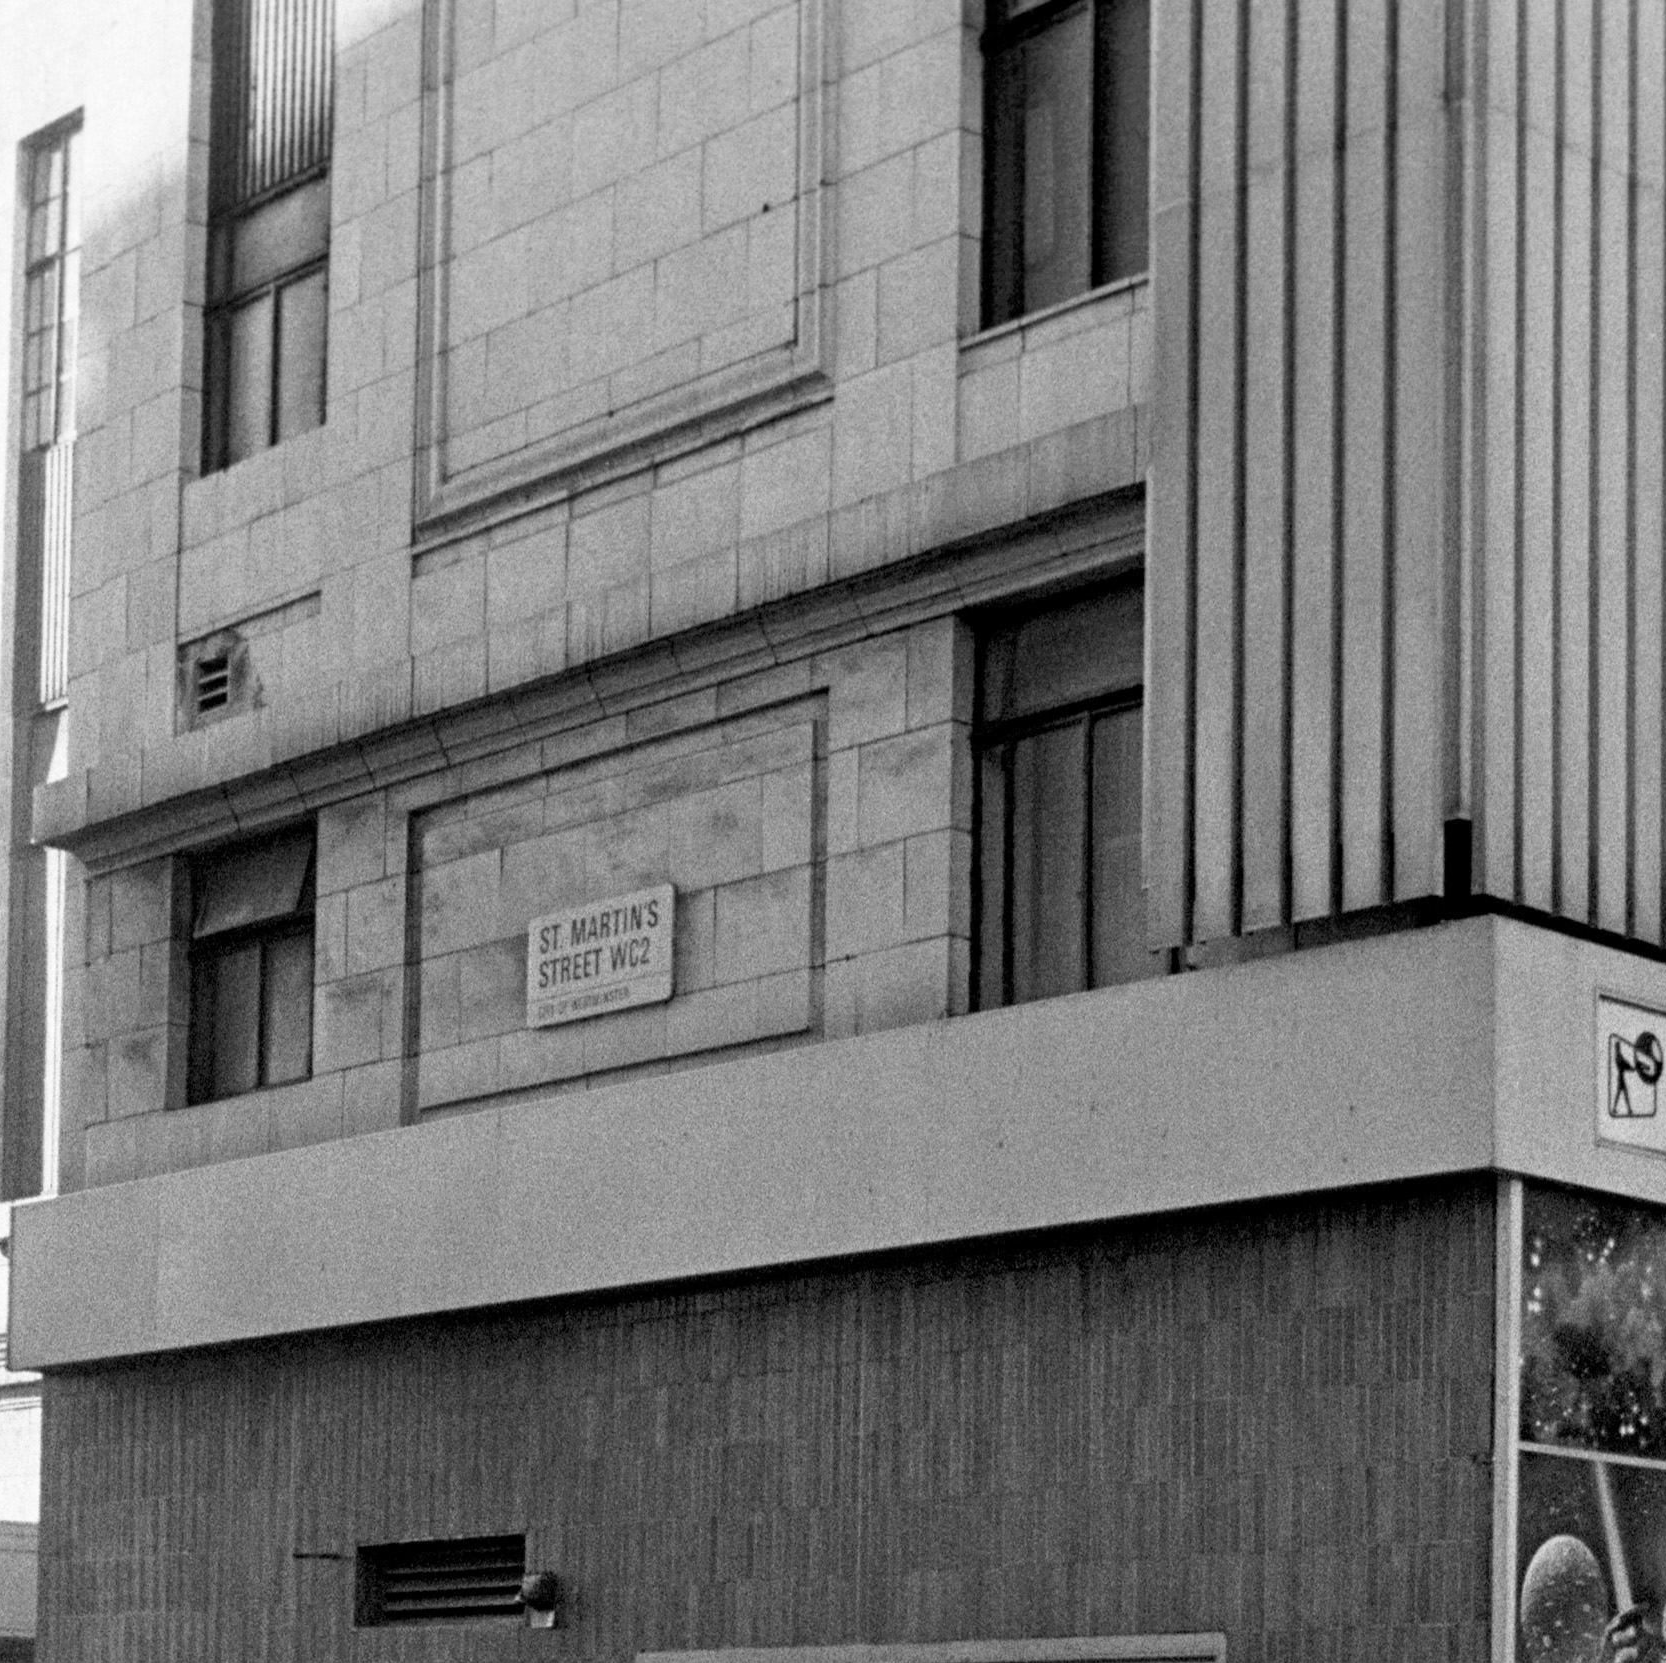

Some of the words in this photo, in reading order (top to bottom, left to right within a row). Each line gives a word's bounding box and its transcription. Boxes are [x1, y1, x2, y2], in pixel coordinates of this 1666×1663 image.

[539, 922, 563, 955] ST.
[570, 899, 659, 946] MARTIN'S
[538, 947, 604, 989] STREET
[610, 938, 652, 970] WC2
